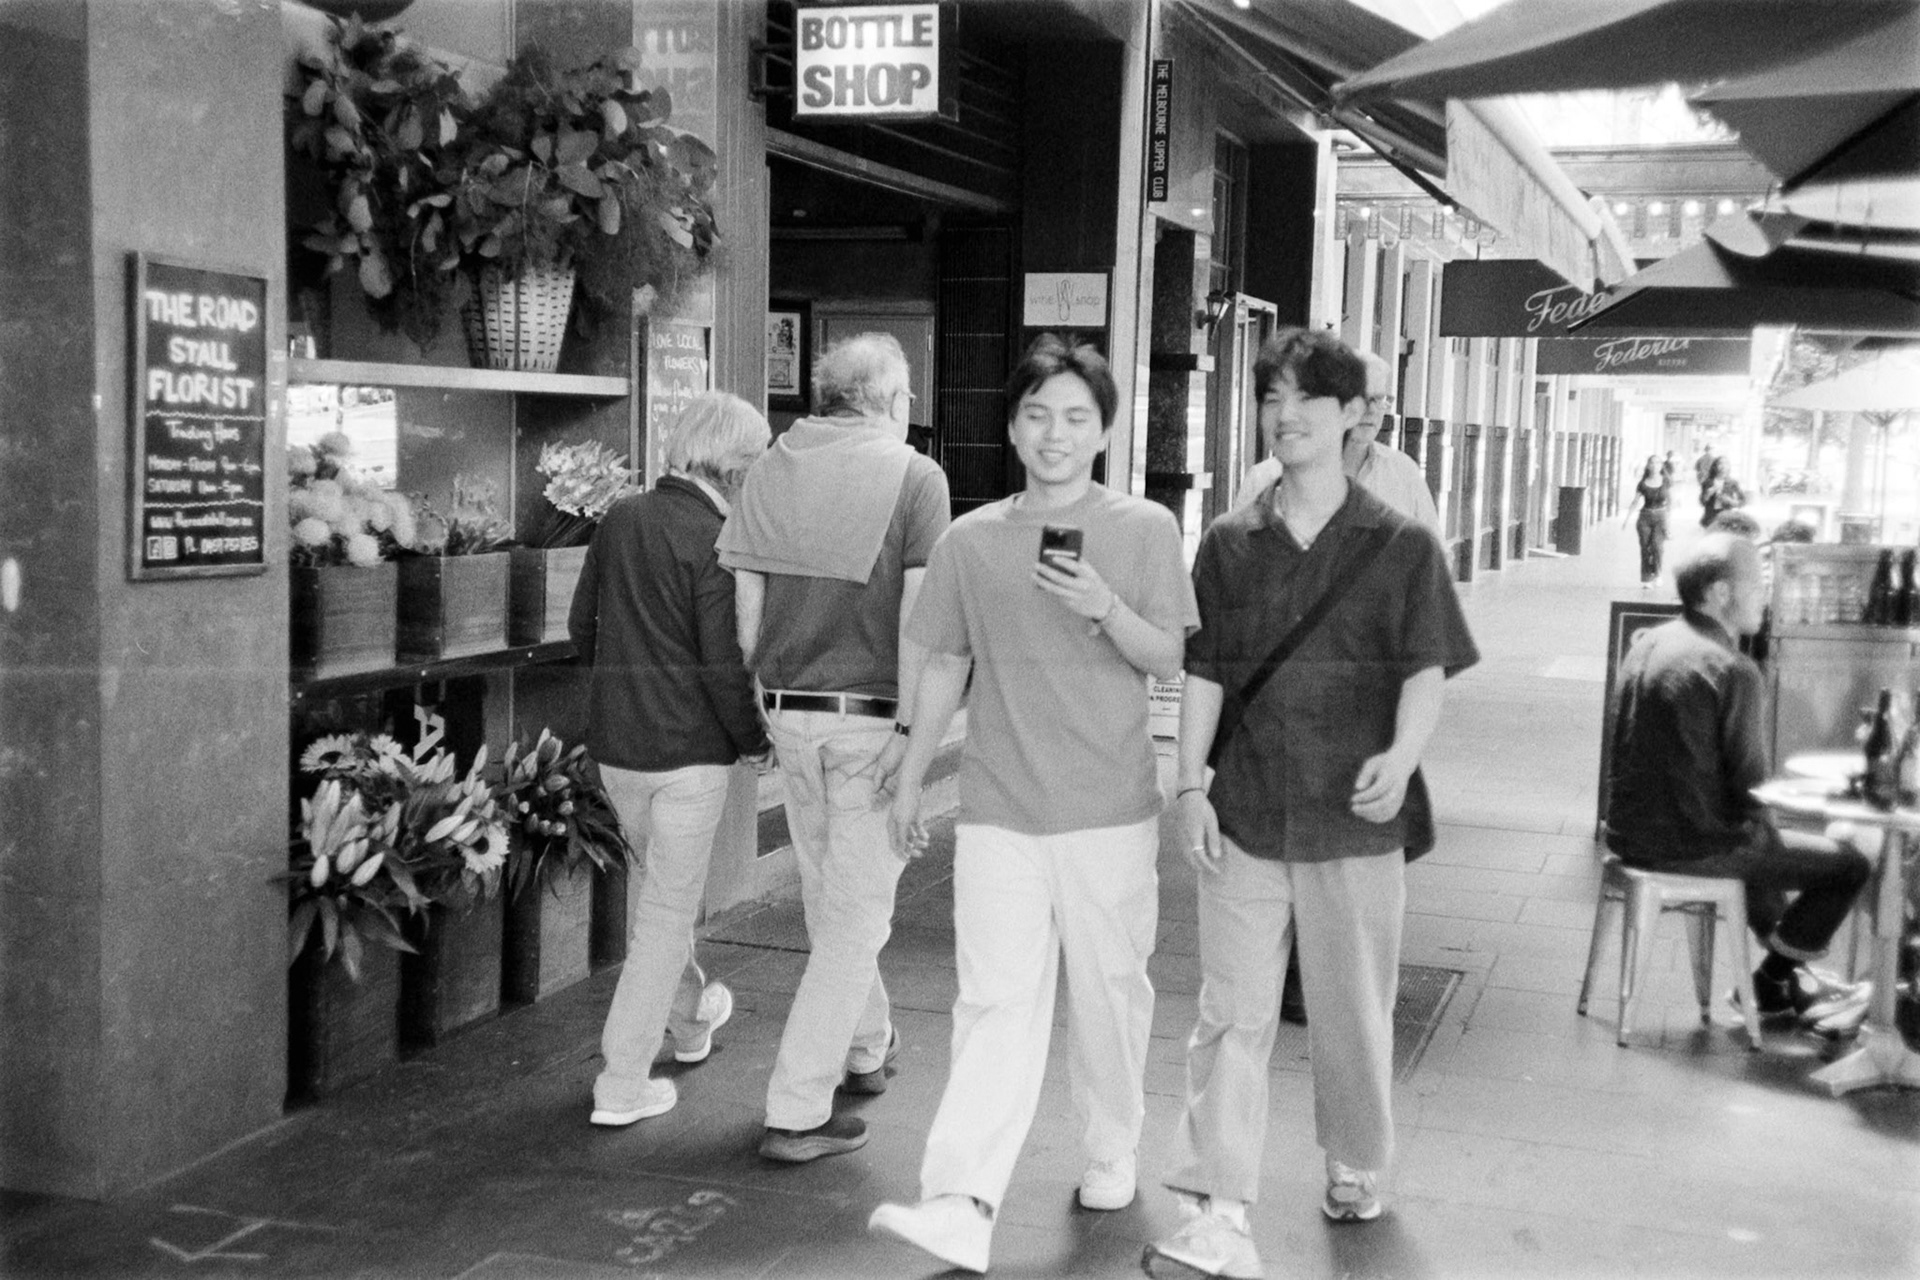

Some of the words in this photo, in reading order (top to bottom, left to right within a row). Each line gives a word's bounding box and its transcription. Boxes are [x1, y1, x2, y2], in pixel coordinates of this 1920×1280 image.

[802, 14, 933, 50] BOTTLE
[803, 62, 931, 107] SHOP
[1157, 64, 1169, 79] THE
[1155, 84, 1168, 135] MELBOURNE
[1153, 141, 1166, 172] SUPPER
[1152, 177, 1164, 198] CLUB
[145, 291, 197, 328] THE
[199, 296, 257, 332] ROAD
[1524, 283, 1606, 332] Fede
[170, 336, 237, 371] STALL
[148, 369, 254, 409] FLORIST
